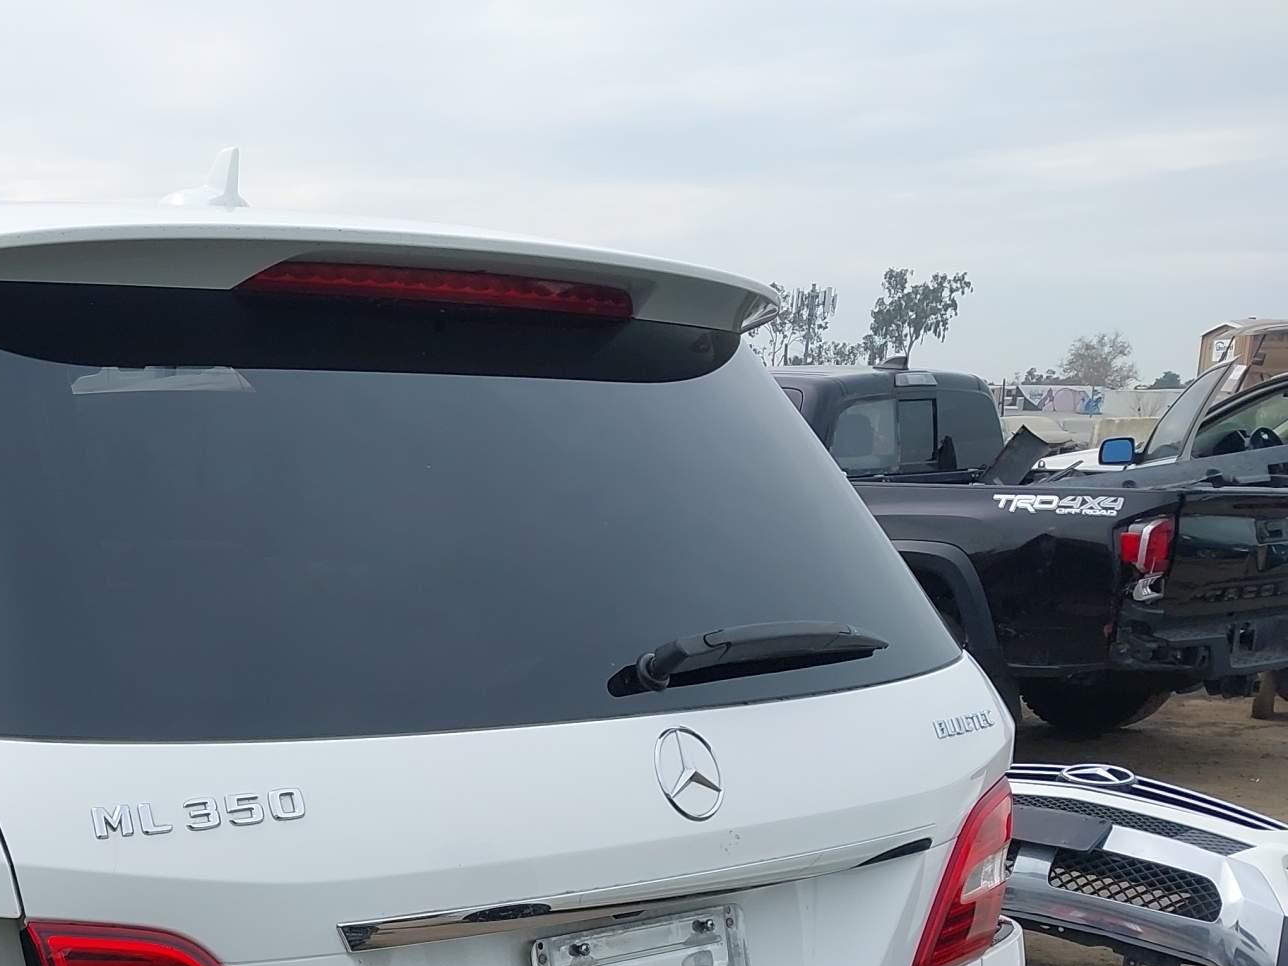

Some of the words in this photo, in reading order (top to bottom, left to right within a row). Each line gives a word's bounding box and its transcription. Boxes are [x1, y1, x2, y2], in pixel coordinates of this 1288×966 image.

[1055, 507, 1081, 515] OFF
[1081, 509, 1118, 517] ROAD
[91, 802, 173, 840] ML
[183, 787, 306, 831] 350
